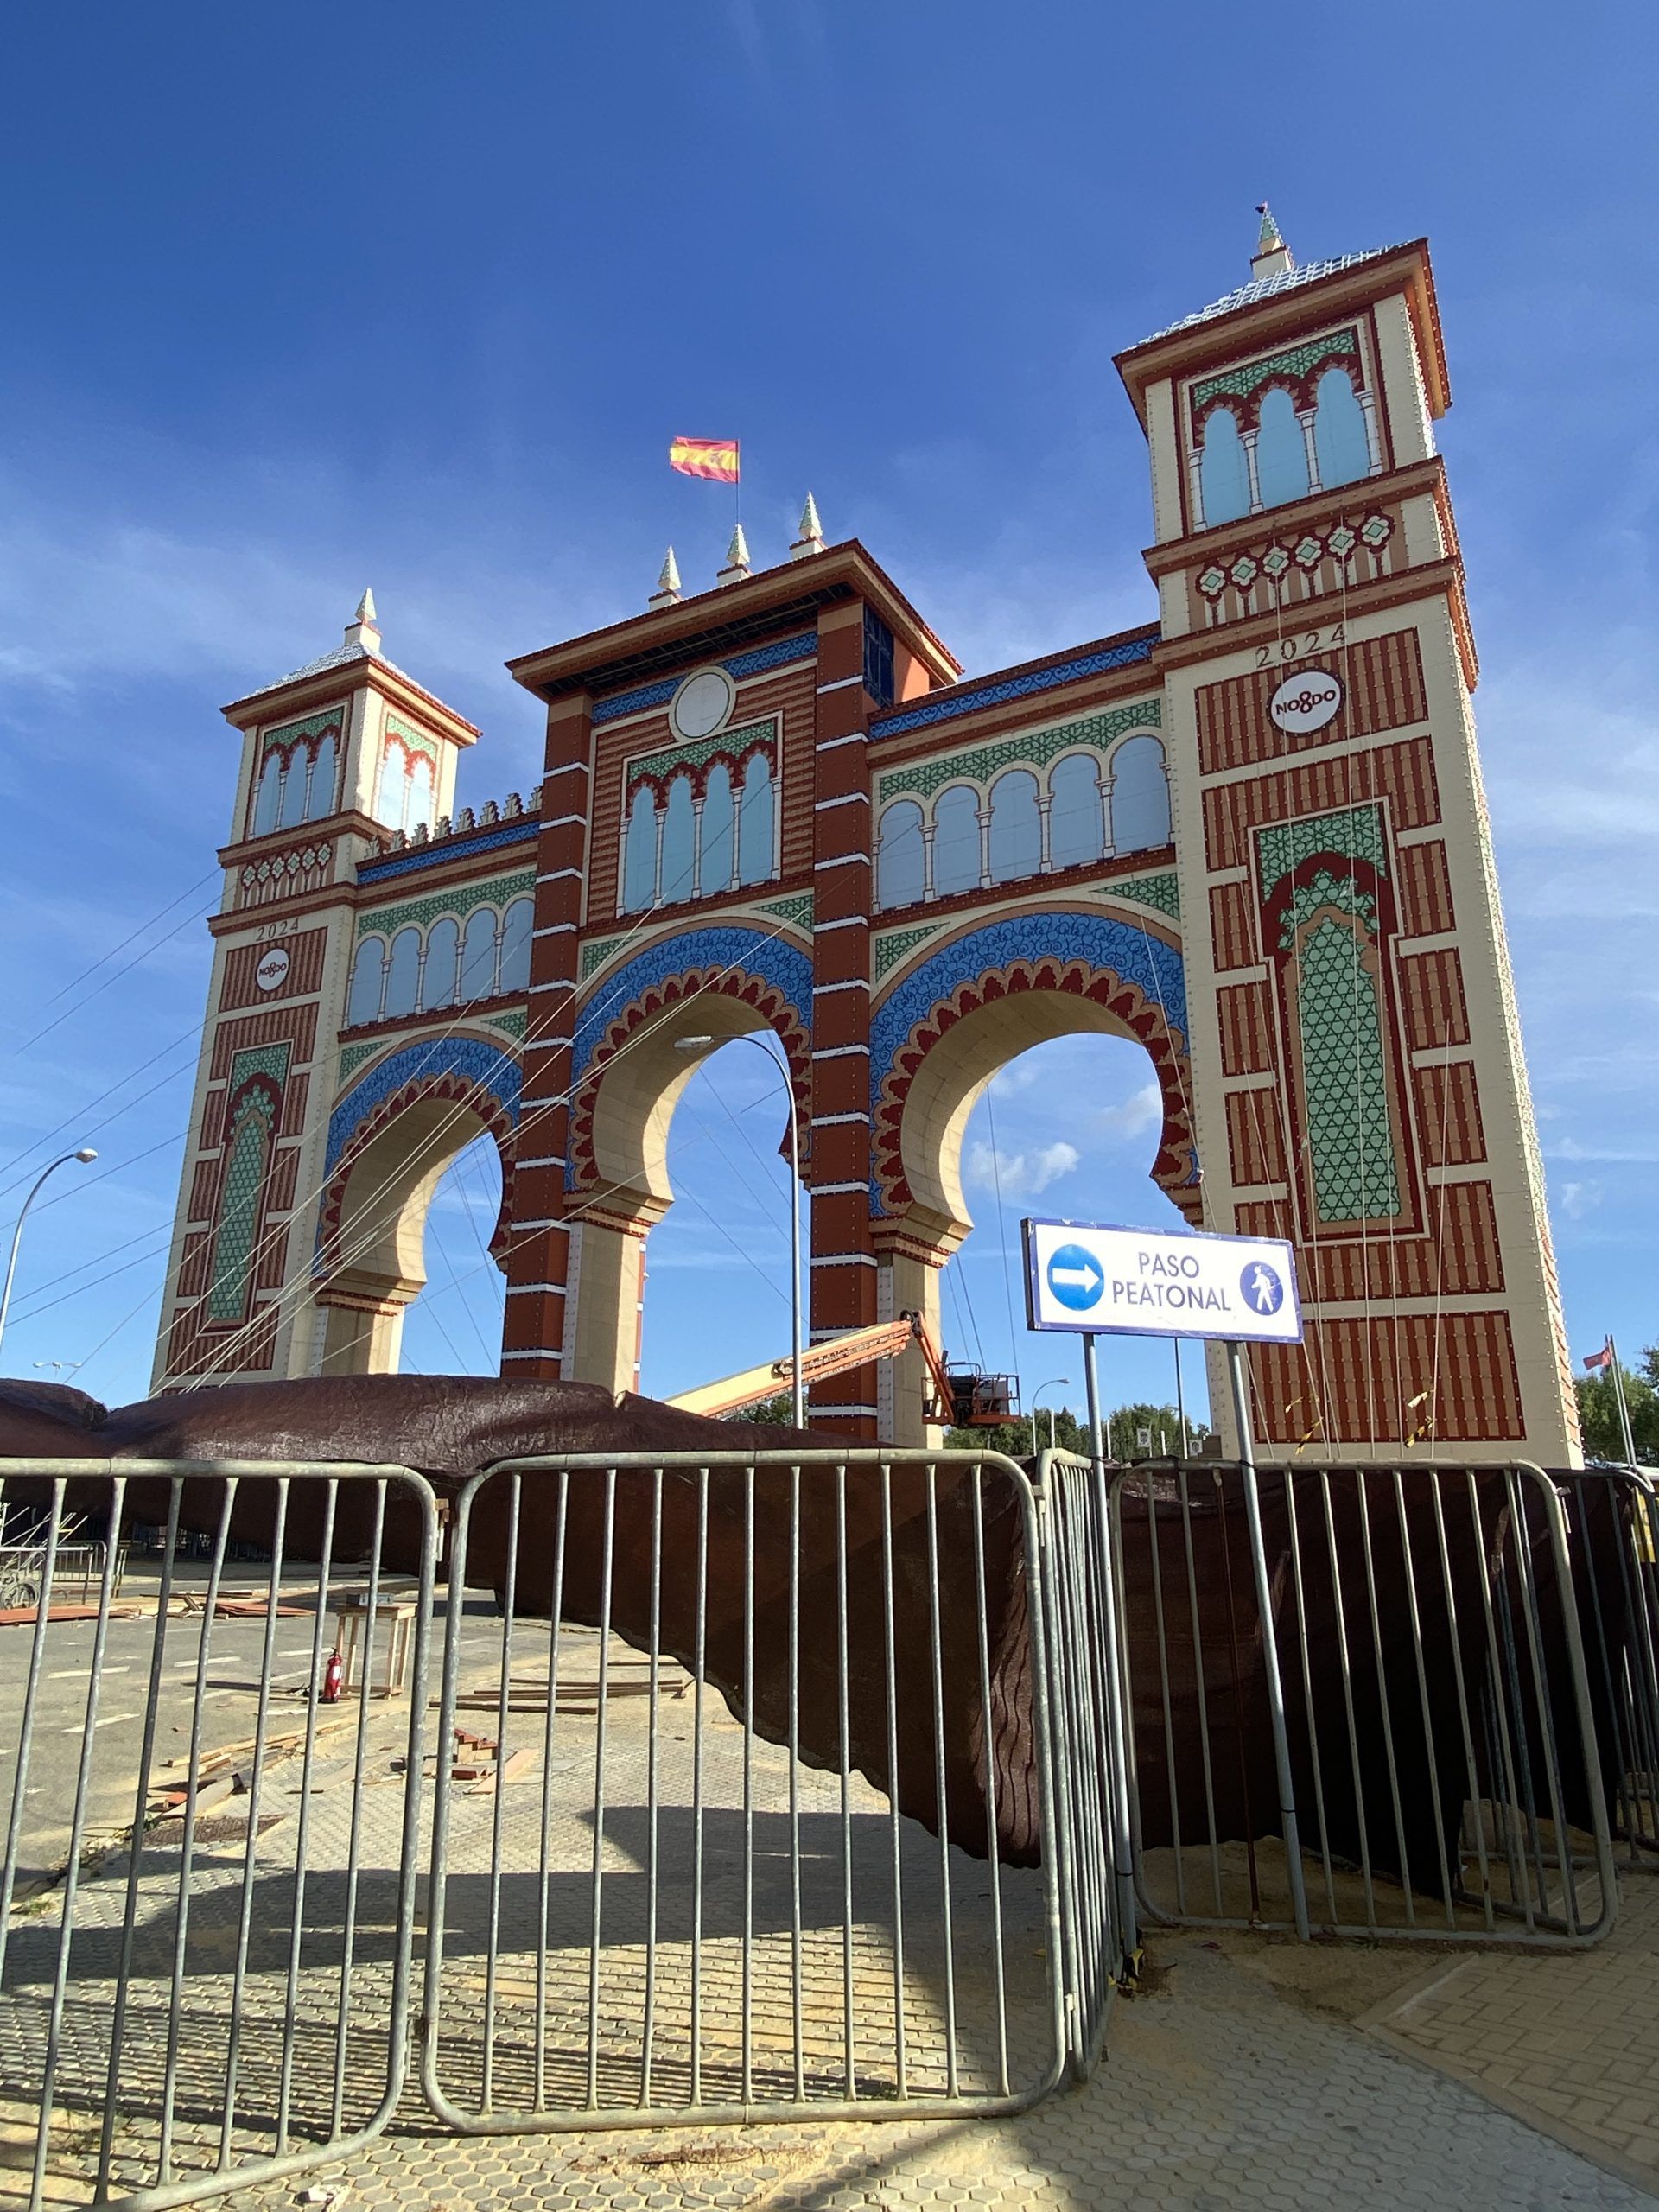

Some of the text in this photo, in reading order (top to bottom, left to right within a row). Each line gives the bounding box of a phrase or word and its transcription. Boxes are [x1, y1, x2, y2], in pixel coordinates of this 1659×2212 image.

[1255, 623, 1346, 668] 2024
[256, 917, 299, 941] 2024
[1137, 1251, 1199, 1278] PASO
[1112, 1280, 1231, 1312] PEATONAL
